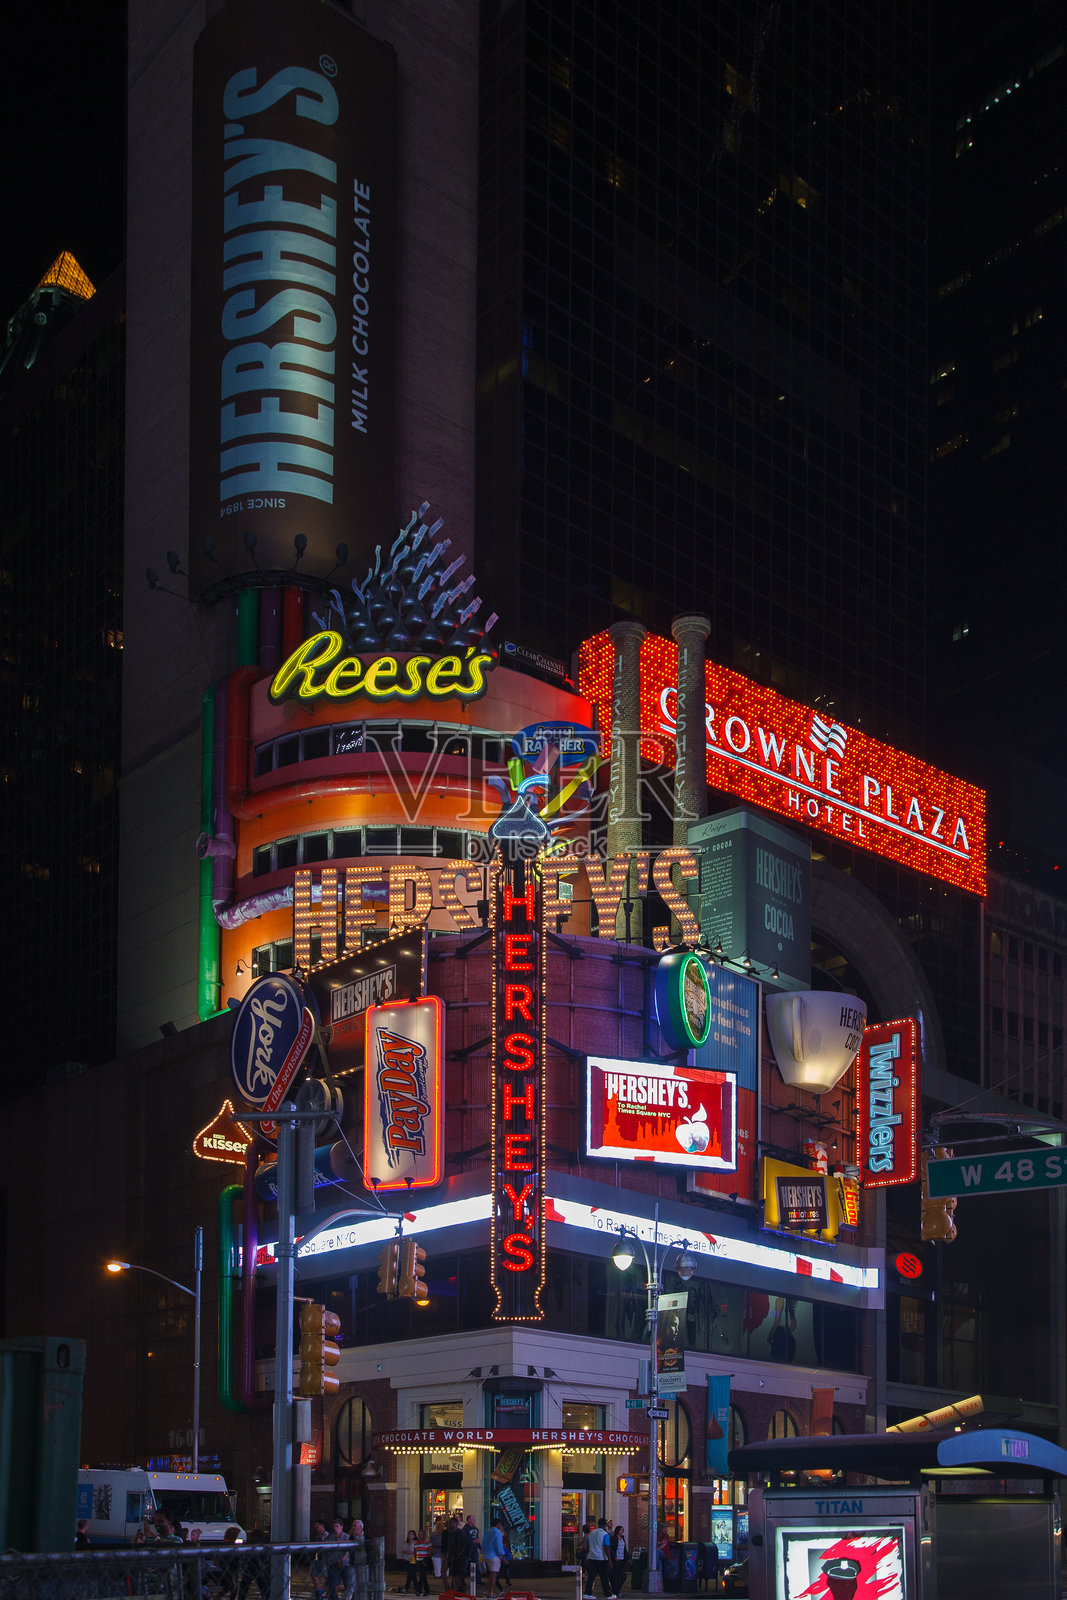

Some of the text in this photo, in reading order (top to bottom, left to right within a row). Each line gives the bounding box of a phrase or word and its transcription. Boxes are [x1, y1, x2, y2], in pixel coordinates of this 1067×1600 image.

[220, 66, 340, 504] HERSHEY'S
[351, 179, 370, 434] MILK CHOCOLATE
[220, 498, 286, 518] SINCE 1894
[270, 630, 493, 699] Reese's
[525, 738, 582, 752] RAHER
[788, 790, 867, 838] HOTEL
[864, 775, 971, 851] PLAZA
[712, 840, 733, 852] COCOA
[756, 847, 804, 905] HERSHEY'S
[293, 847, 700, 969] HERSEY'S
[764, 903, 795, 942] COCOA
[710, 996, 749, 1018] metimes
[717, 1013, 735, 1029] feel
[736, 1021, 751, 1036] like
[247, 989, 288, 1093] York
[272, 1084, 284, 1104] the
[281, 1023, 310, 1083] sensation!
[607, 1072, 688, 1109] HERSHEY'S
[636, 1109, 657, 1117] Square
[869, 1033, 902, 1174] Twizzlers
[961, 1164, 983, 1187] W
[994, 1158, 1035, 1182] 48
[781, 1185, 823, 1208] HERSHEY'S
[788, 1209, 819, 1219] miniatures
[606, 1218, 638, 1236] Rahel
[959, 1402, 979, 1414] PLAZA
[444, 1420, 463, 1428] KISS
[381, 1432, 435, 1443] CHOCOLATE
[443, 1431, 494, 1440] WORLD
[532, 1431, 603, 1441] HERSHEY'S
[430, 1463, 450, 1471] SHARE
[815, 1501, 864, 1515] TITAN
